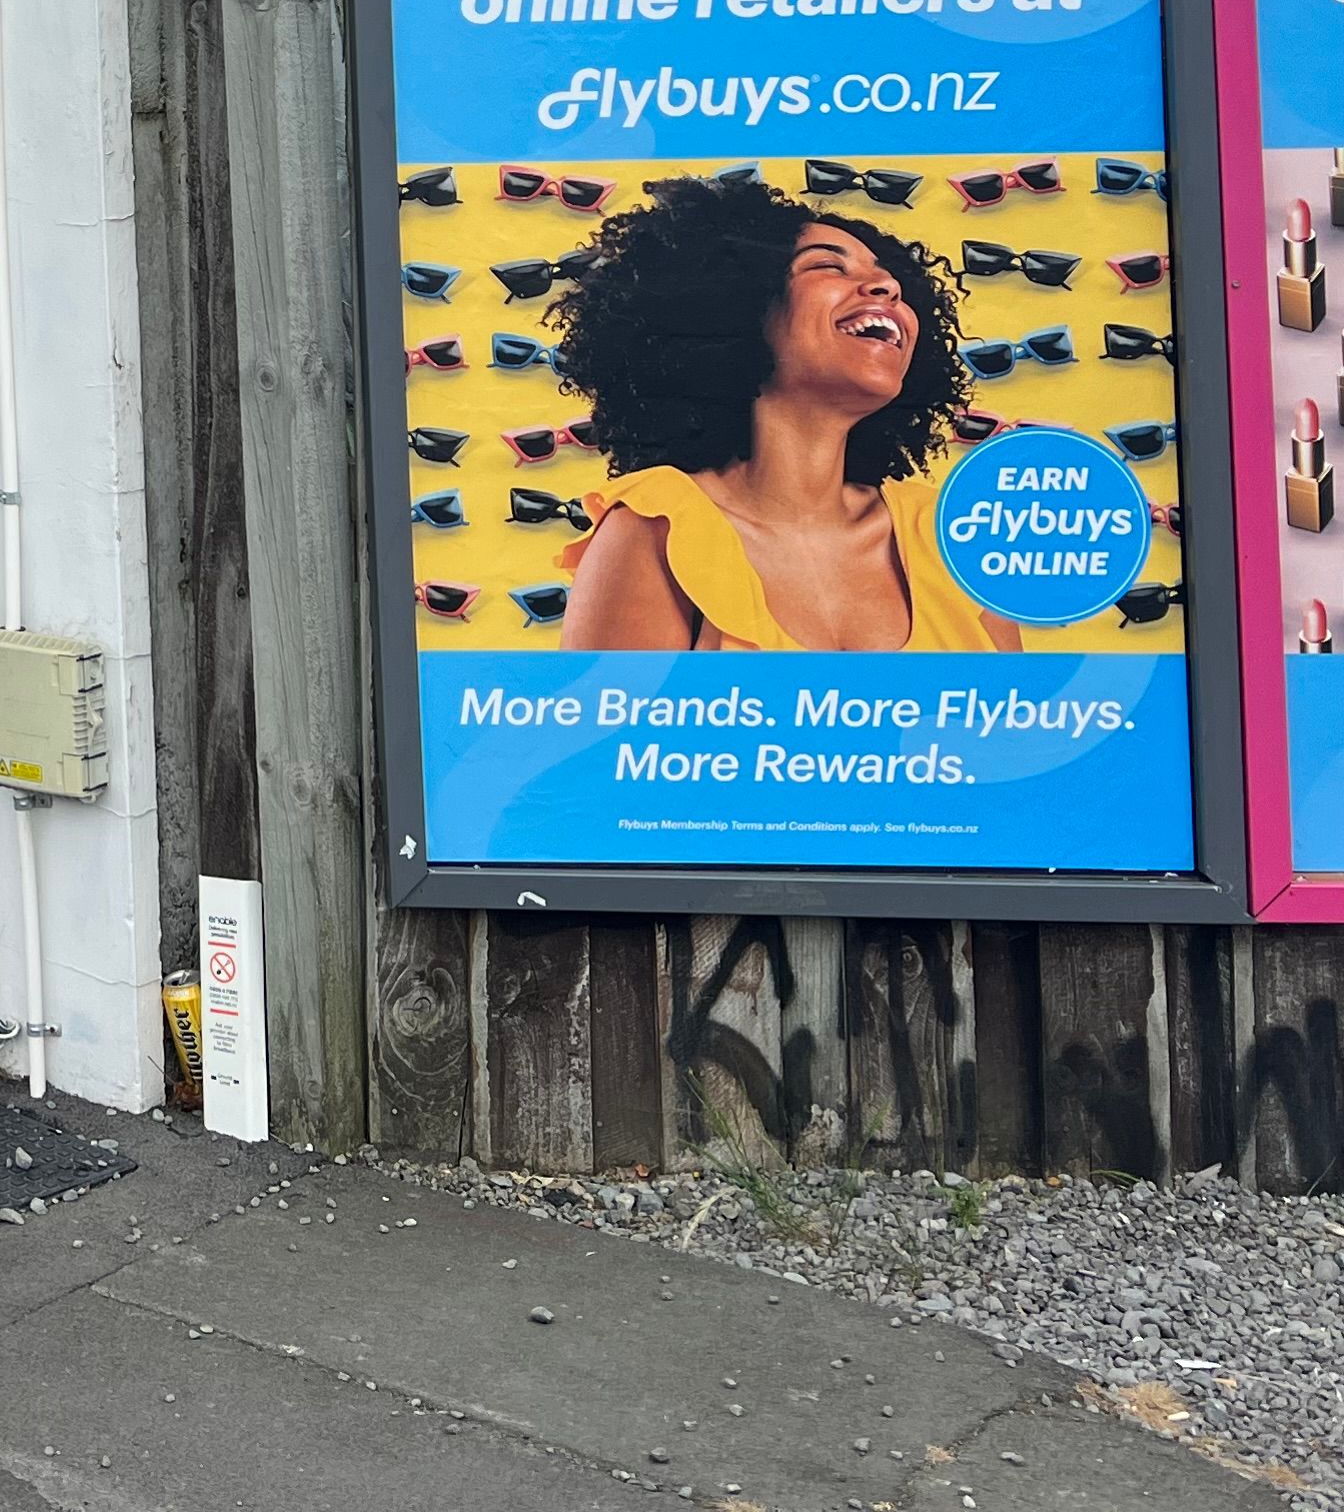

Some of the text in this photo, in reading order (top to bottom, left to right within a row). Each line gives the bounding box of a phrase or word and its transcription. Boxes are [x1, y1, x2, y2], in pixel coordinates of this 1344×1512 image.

[997, 467, 1089, 491] EARN
[949, 501, 1132, 542] flybuys
[981, 551, 1109, 575] ONLINE
[460, 687, 1135, 738] More Brands. More Flybuys.
[615, 743, 976, 784] More Rewards.
[618, 819, 979, 835] Flybuys Membership Terms and Conditions apply. See flybuys.co.nz
[208, 915, 238, 927] enable
